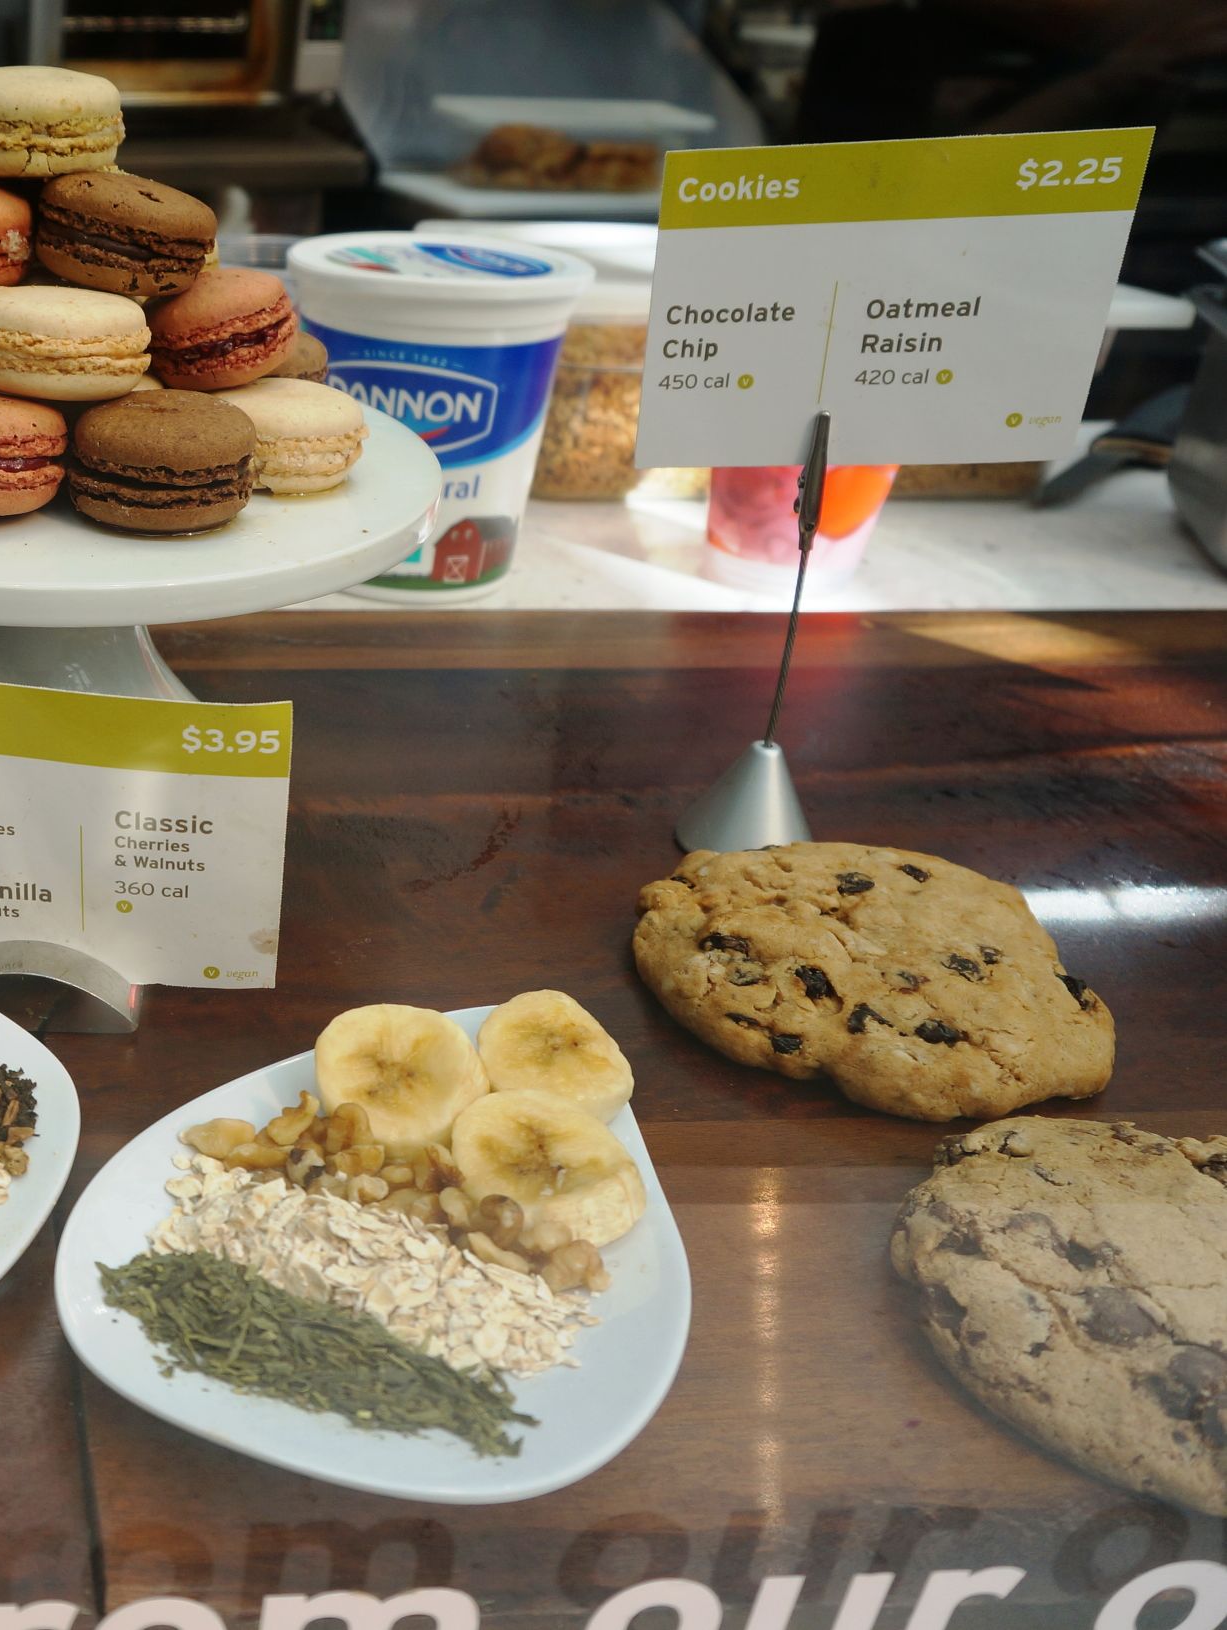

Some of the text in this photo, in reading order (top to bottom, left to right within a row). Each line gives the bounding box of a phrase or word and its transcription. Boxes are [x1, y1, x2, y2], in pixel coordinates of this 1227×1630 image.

[1017, 156, 1123, 191] $2.25
[678, 173, 800, 203] Cookies
[666, 301, 796, 326] Chocolate
[866, 295, 982, 320] Oatmeal
[662, 339, 719, 362] Chip
[861, 332, 943, 354] Raisin
[658, 373, 698, 390] 450
[703, 372, 730, 389] cal
[855, 369, 895, 386] 420
[901, 368, 929, 385] cal
[181, 725, 281, 755] $3.95
[114, 810, 214, 835] Classic
[114, 836, 190, 853] Cherries
[114, 855, 206, 872] & Walnuts
[114, 881, 189, 898] 360 cal
[226, 970, 258, 981] vegan
